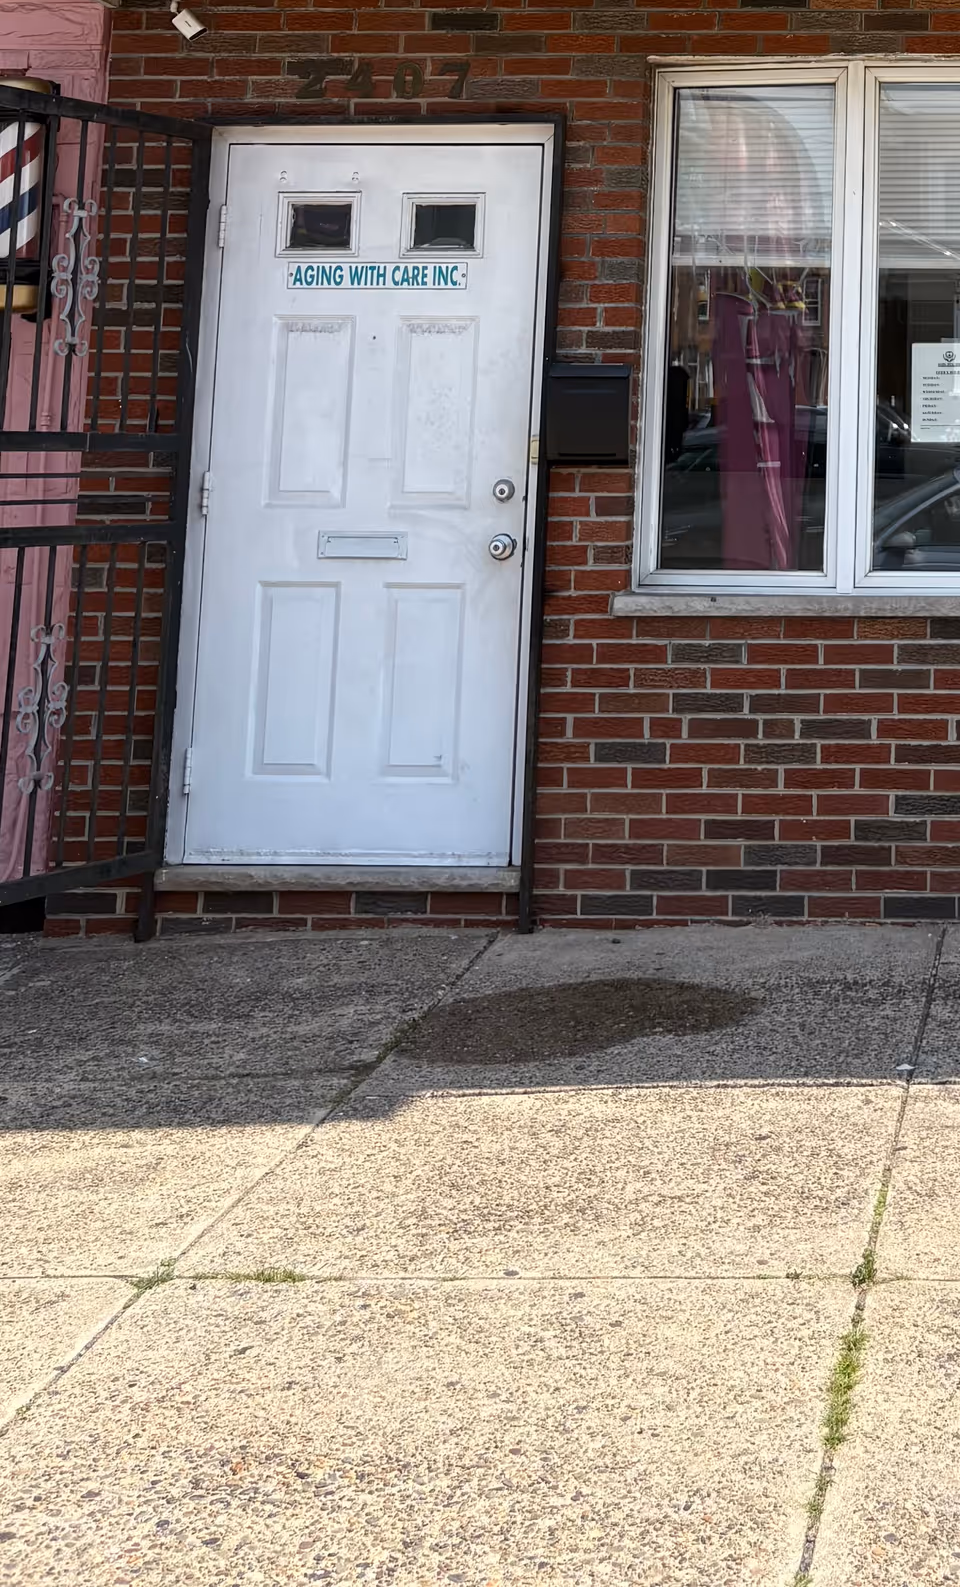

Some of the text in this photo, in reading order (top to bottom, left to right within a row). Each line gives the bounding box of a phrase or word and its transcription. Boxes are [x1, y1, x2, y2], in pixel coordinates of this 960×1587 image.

[295, 61, 471, 100] 2407
[292, 265, 461, 287] AGING WITH CARE INC.
